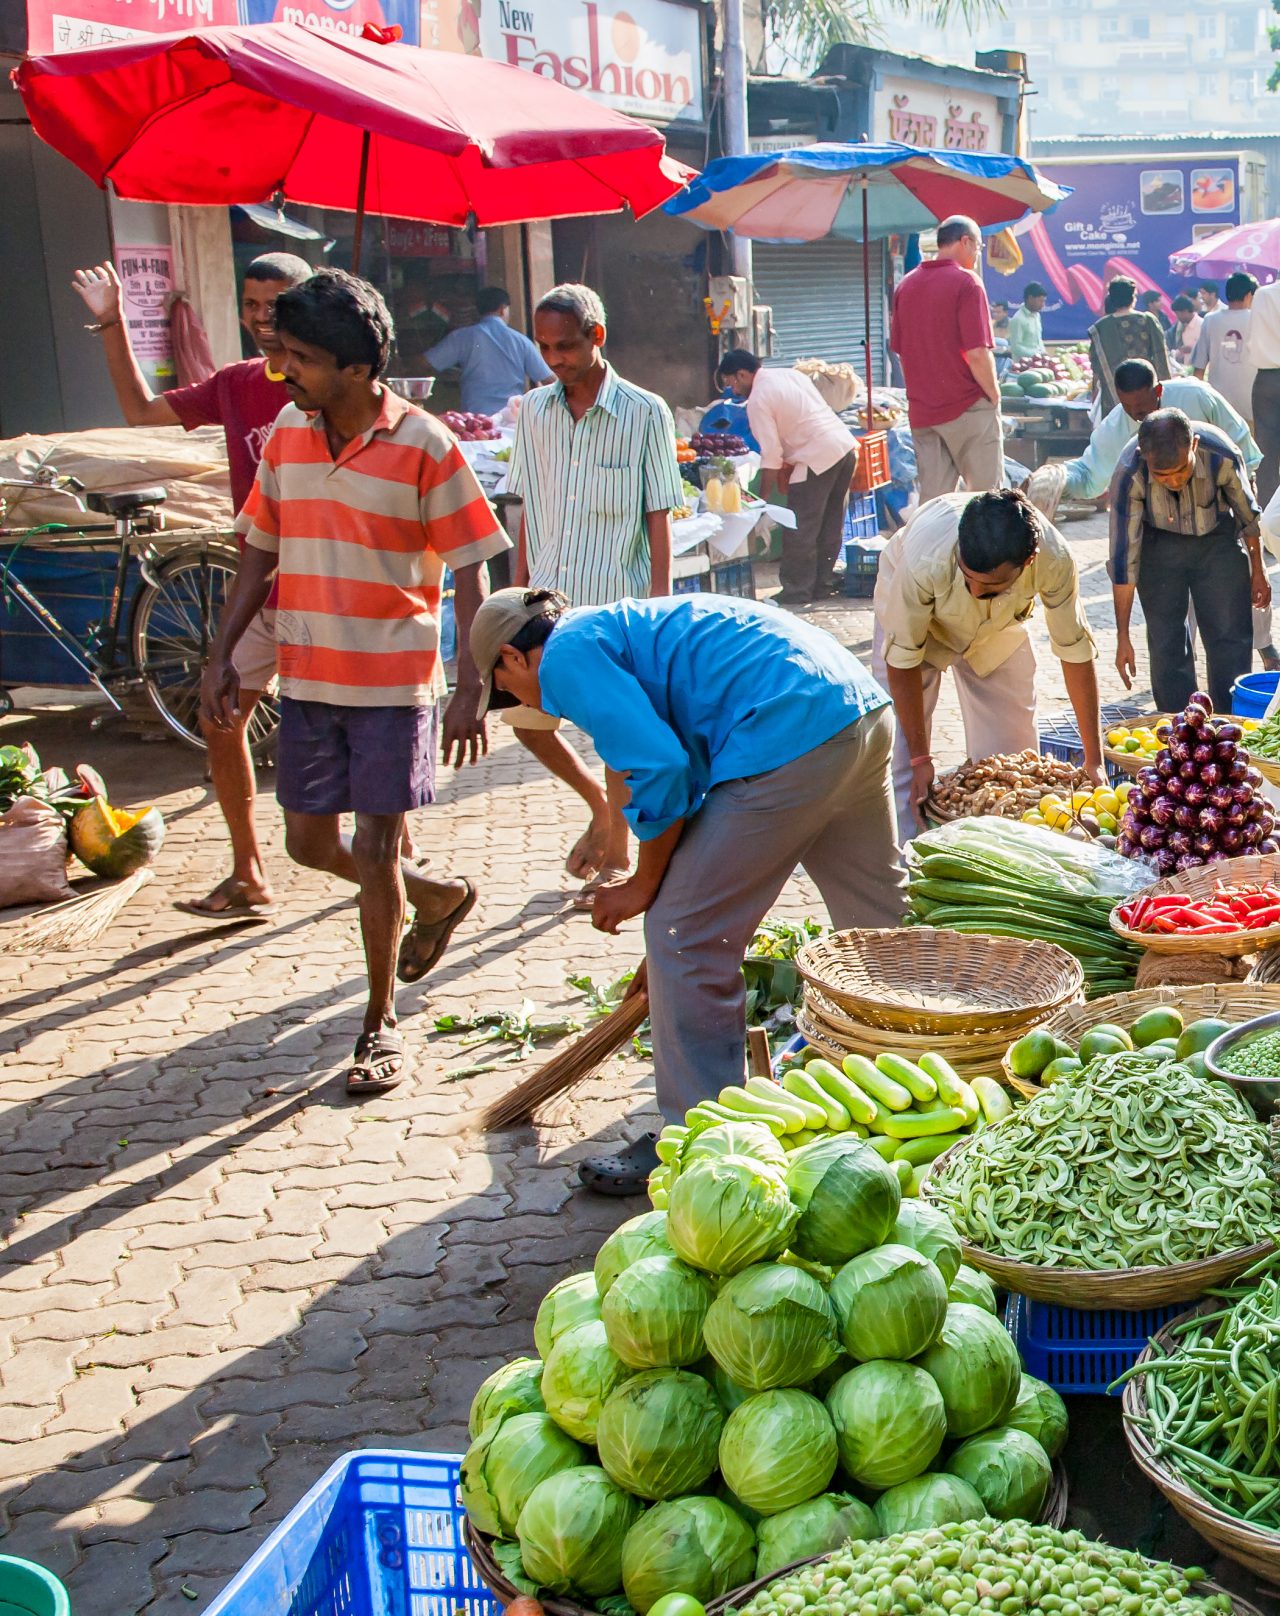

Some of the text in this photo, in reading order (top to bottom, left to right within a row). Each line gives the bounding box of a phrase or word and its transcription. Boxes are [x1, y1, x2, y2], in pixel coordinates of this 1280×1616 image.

[499, 1, 534, 33] New
[501, 1, 694, 106] Fashion
[1064, 222, 1094, 232] Gift a
[1080, 231, 1107, 240] Cake
[121, 258, 170, 280] FUN-N-FAIR
